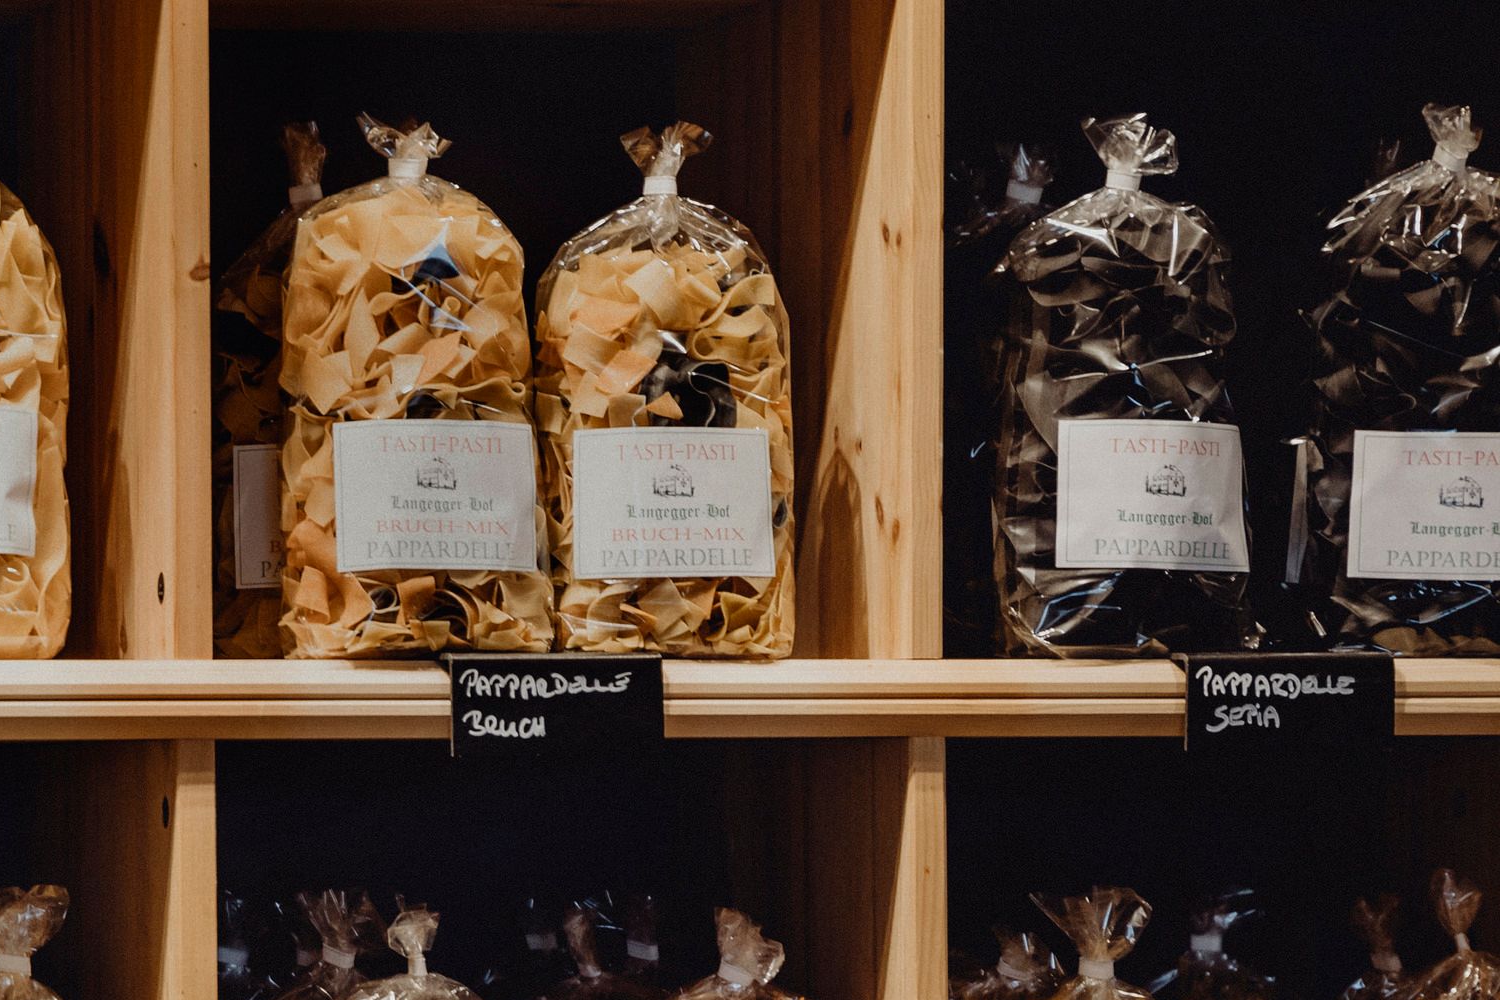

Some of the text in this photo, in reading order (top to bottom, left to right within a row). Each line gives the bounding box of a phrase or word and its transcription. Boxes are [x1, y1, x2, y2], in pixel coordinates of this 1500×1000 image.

[379, 436, 503, 454] TASTI-PASTI
[617, 443, 738, 461] TASTI-PASTI
[1109, 438, 1220, 457] TASTI-PASTI
[376, 519, 510, 535] BRUCH-MIX
[610, 527, 746, 542] BRUCH-MIX
[367, 541, 516, 560] PAPPARDELLE
[601, 548, 754, 567] PAPPARDELLE
[1094, 539, 1231, 559] PAPPARDELLE
[1195, 665, 1356, 699] PAPPARDELLE
